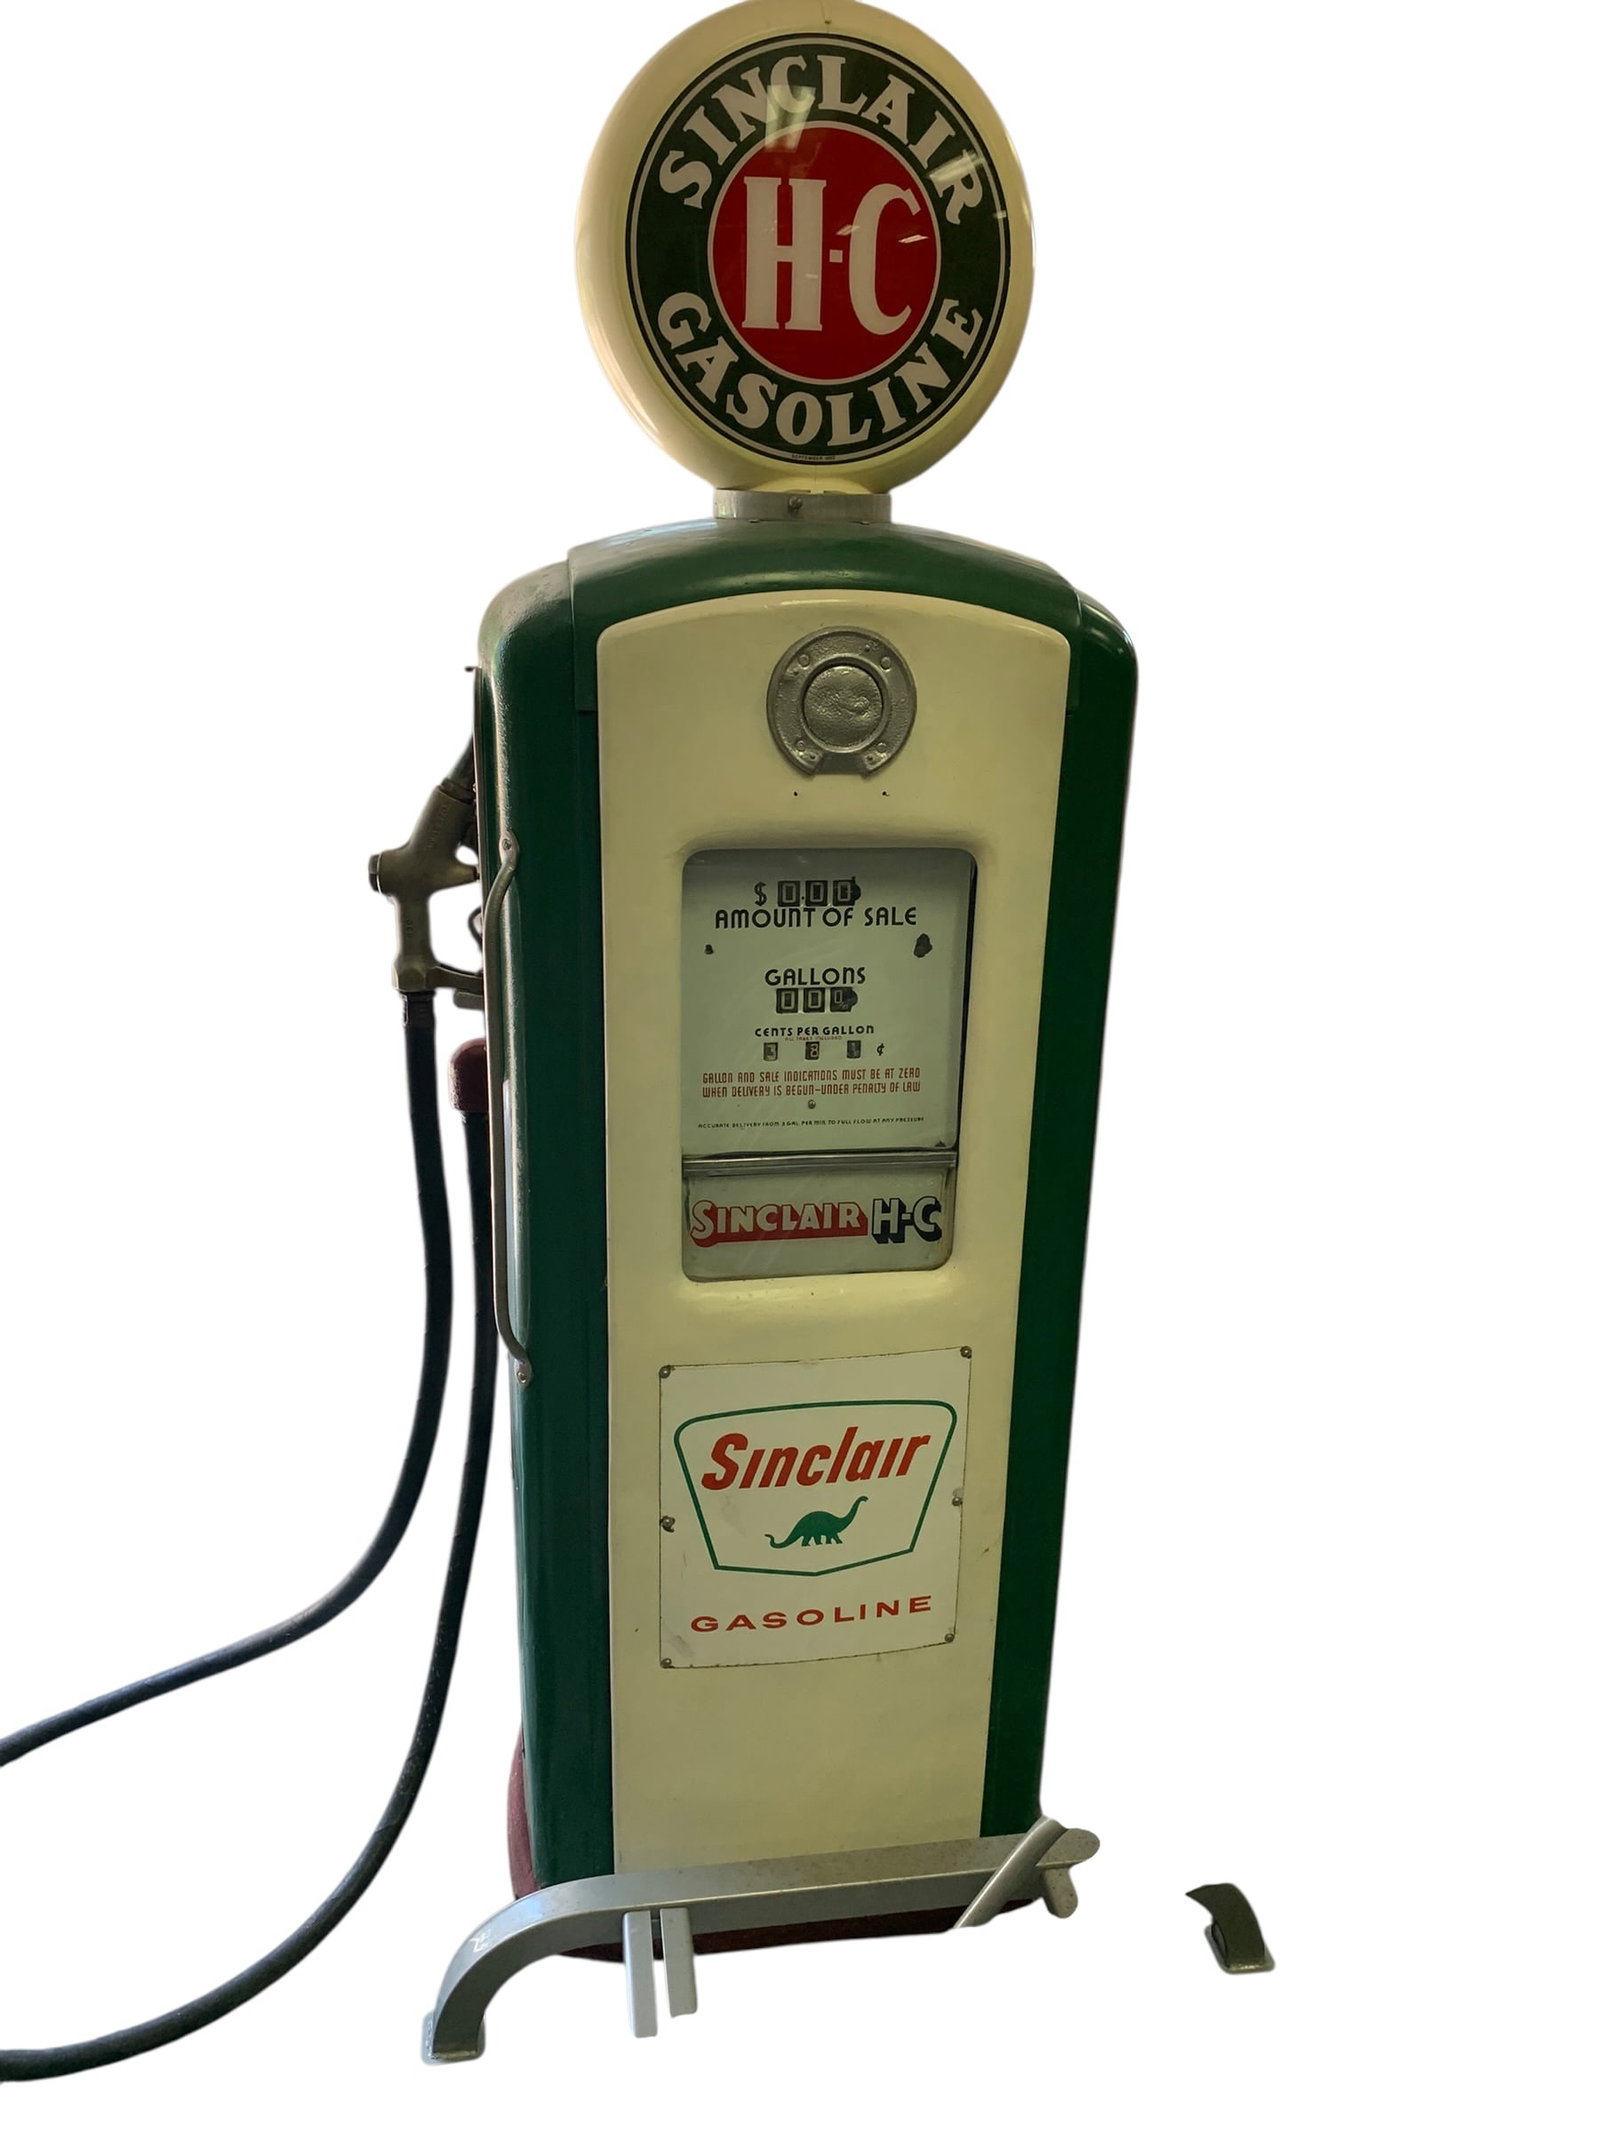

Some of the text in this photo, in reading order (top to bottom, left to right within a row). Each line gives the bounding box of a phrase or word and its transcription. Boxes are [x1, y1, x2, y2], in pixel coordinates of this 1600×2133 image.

[659, 55, 983, 224] SINCLAIR
[657, 291, 983, 446] GASOLINE
[754, 881, 767, 907] $
[715, 906, 917, 929] AMOUNT OF SALE
[764, 967, 866, 986] GALLONS
[754, 1025, 875, 1037] CENTS PER GALLON
[702, 1067, 920, 1084] GALLON AND SALE INDICATIONS MUST BE AT ZERO
[702, 1086, 727, 1098] WHEN
[732, 1085, 770, 1097] DELIVERY
[773, 1085, 782, 1096] IS
[852, 1083, 886, 1094] PENALTY
[889, 1082, 899, 1093] OF
[902, 1081, 920, 1092] LAW
[690, 1196, 943, 1247] SINCLAIR H-C
[701, 1426, 931, 1491] Sinclair
[690, 1595, 932, 1633] GASOLINE
